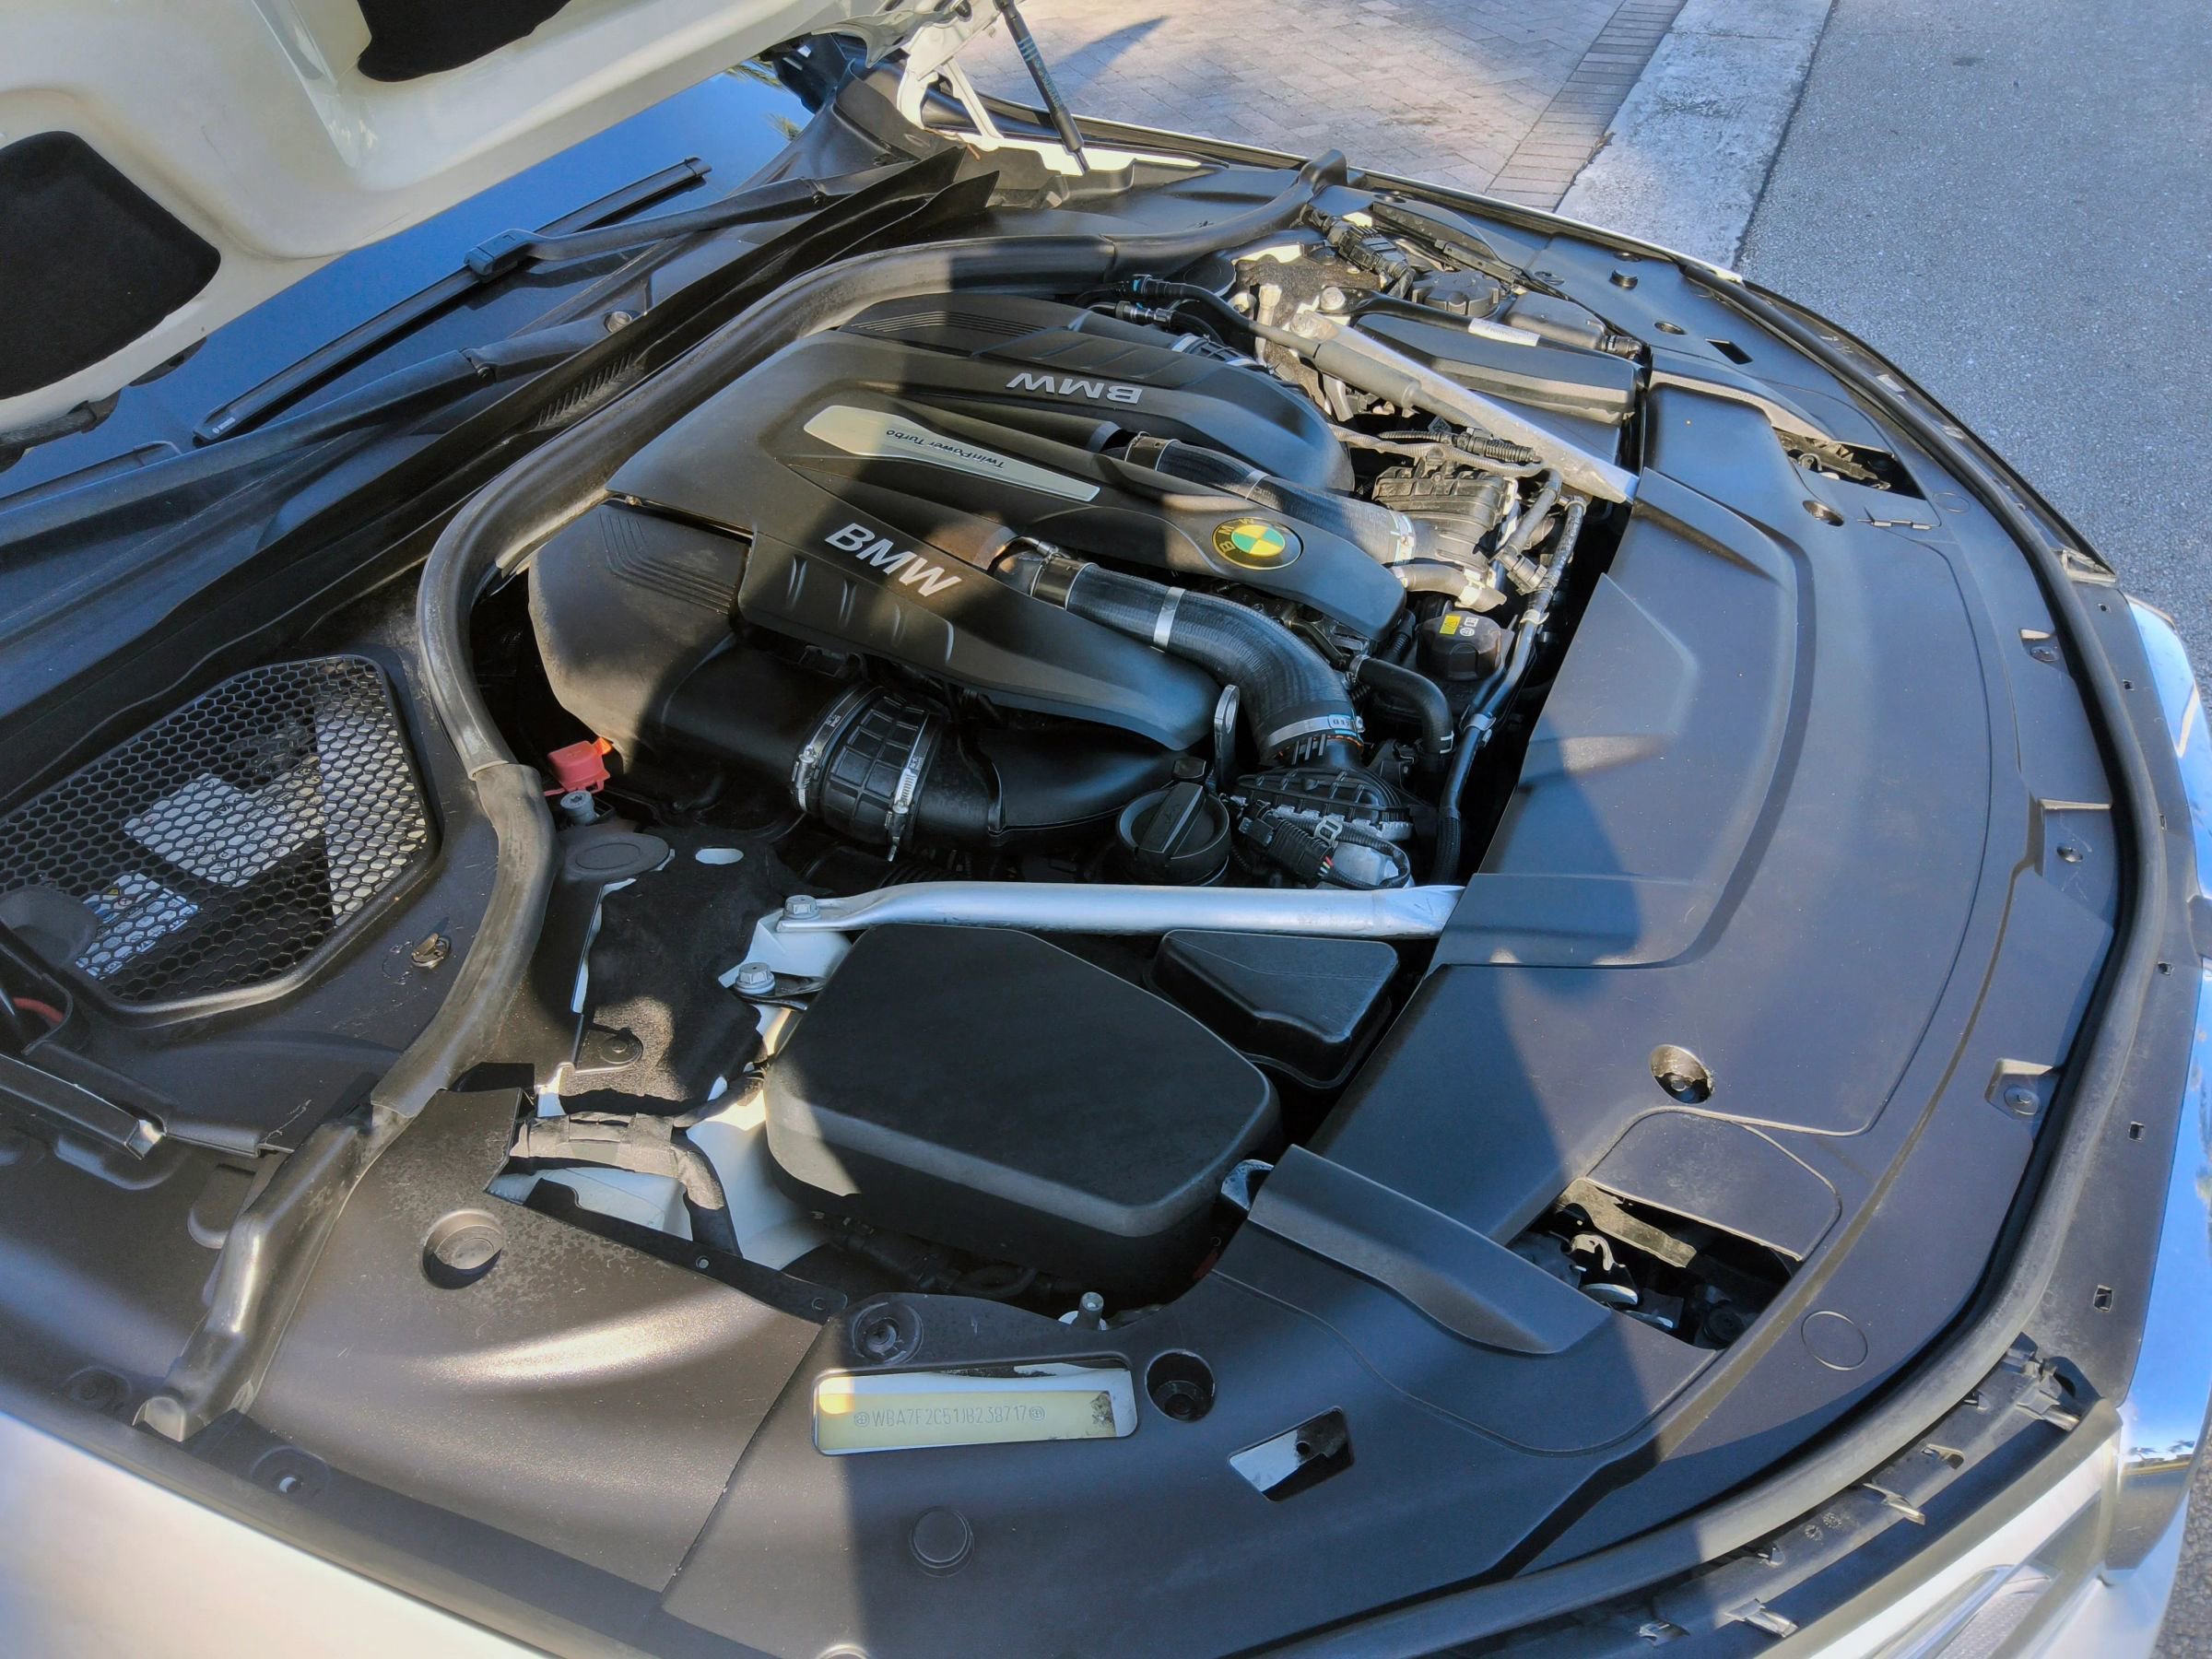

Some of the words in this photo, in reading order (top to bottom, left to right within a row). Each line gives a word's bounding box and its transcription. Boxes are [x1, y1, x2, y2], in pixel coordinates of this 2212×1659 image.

[1006, 372, 1143, 404] BMW
[886, 429, 926, 447] Turbo
[927, 441, 1006, 469] TwinPower
[1218, 518, 1255, 554] BMW
[825, 523, 961, 596] BMW
